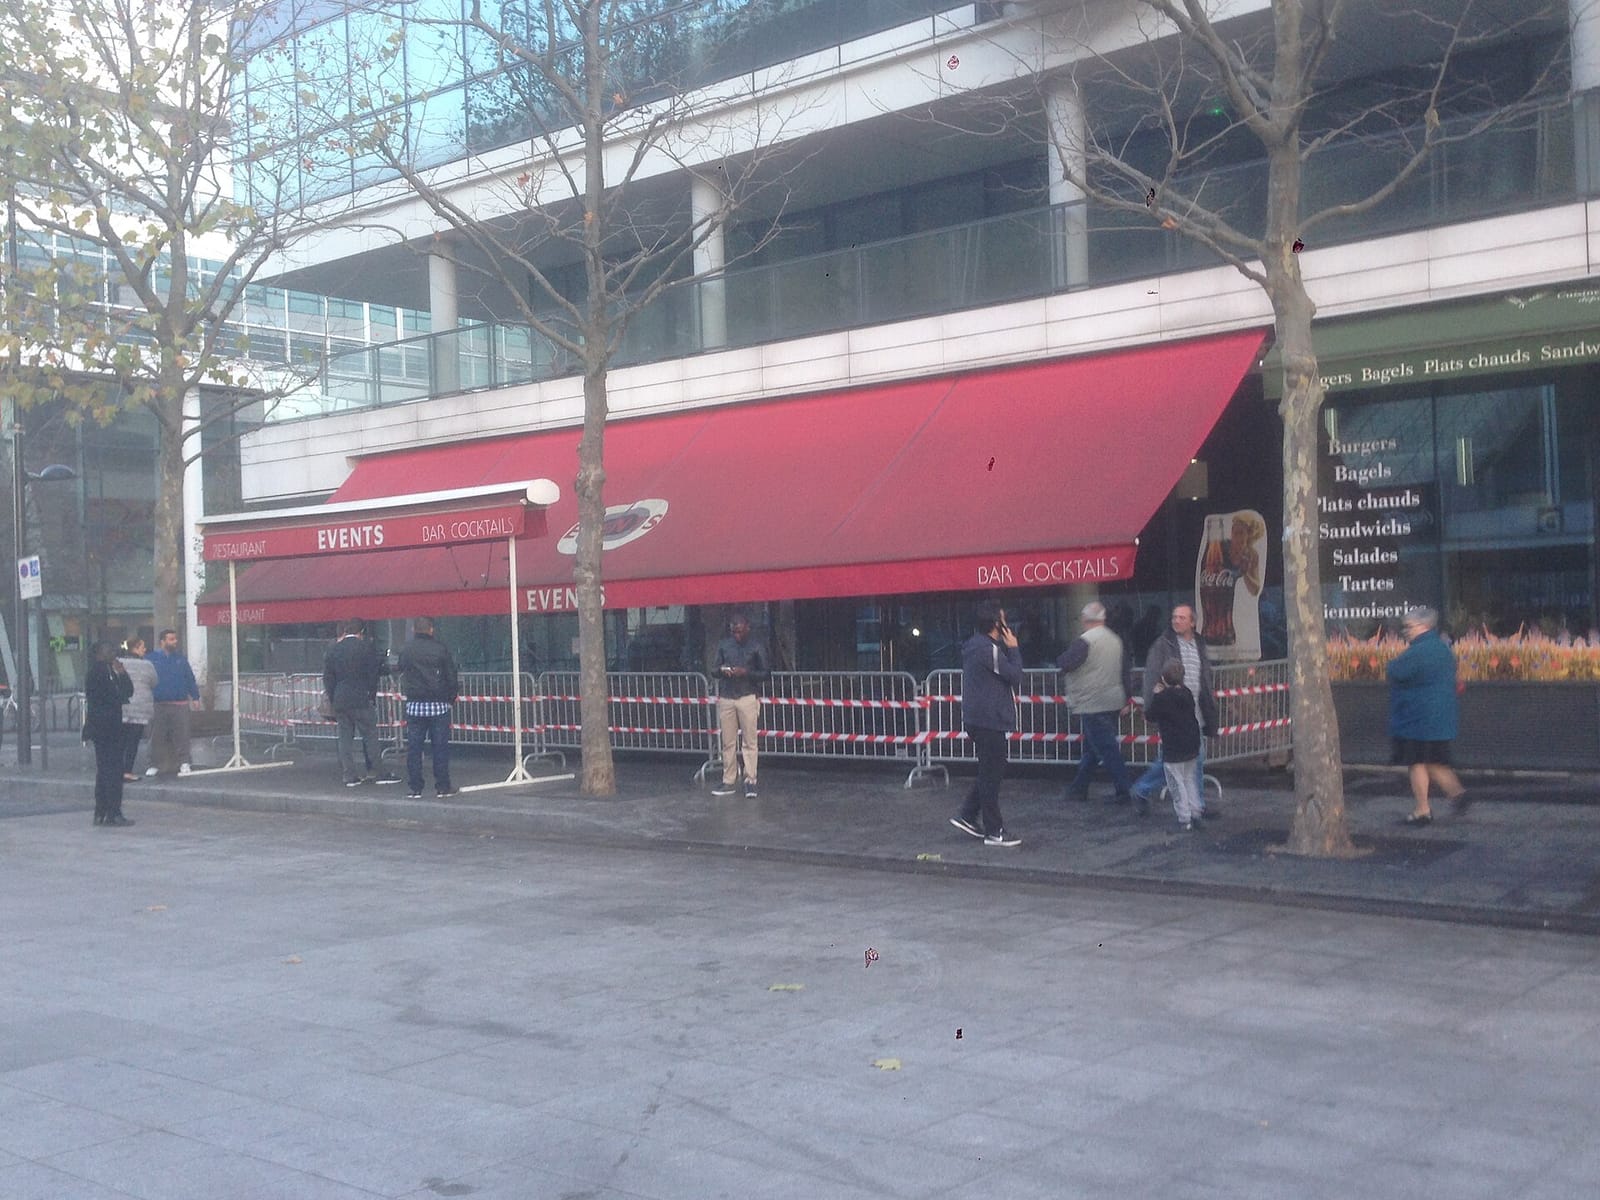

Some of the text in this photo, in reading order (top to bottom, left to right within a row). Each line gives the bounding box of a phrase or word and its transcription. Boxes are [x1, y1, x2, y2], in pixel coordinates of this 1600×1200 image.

[1320, 372, 1352, 389] gers
[1361, 362, 1414, 385] Bagels
[1424, 358, 1464, 374] Plats
[1468, 349, 1531, 369] chauds
[1328, 438, 1397, 457] Burgers
[1334, 462, 1392, 485] Bagels
[1357, 489, 1420, 510] chauds
[212, 516, 515, 559] RESTAURANT EVENTS BAR COCKTAILS
[1319, 518, 1412, 539] Sandwichs
[1333, 546, 1398, 567] Salades
[217, 556, 1120, 624] RESAURANT EVENS BAR COCKTAILS
[1338, 575, 1394, 593] Tartes
